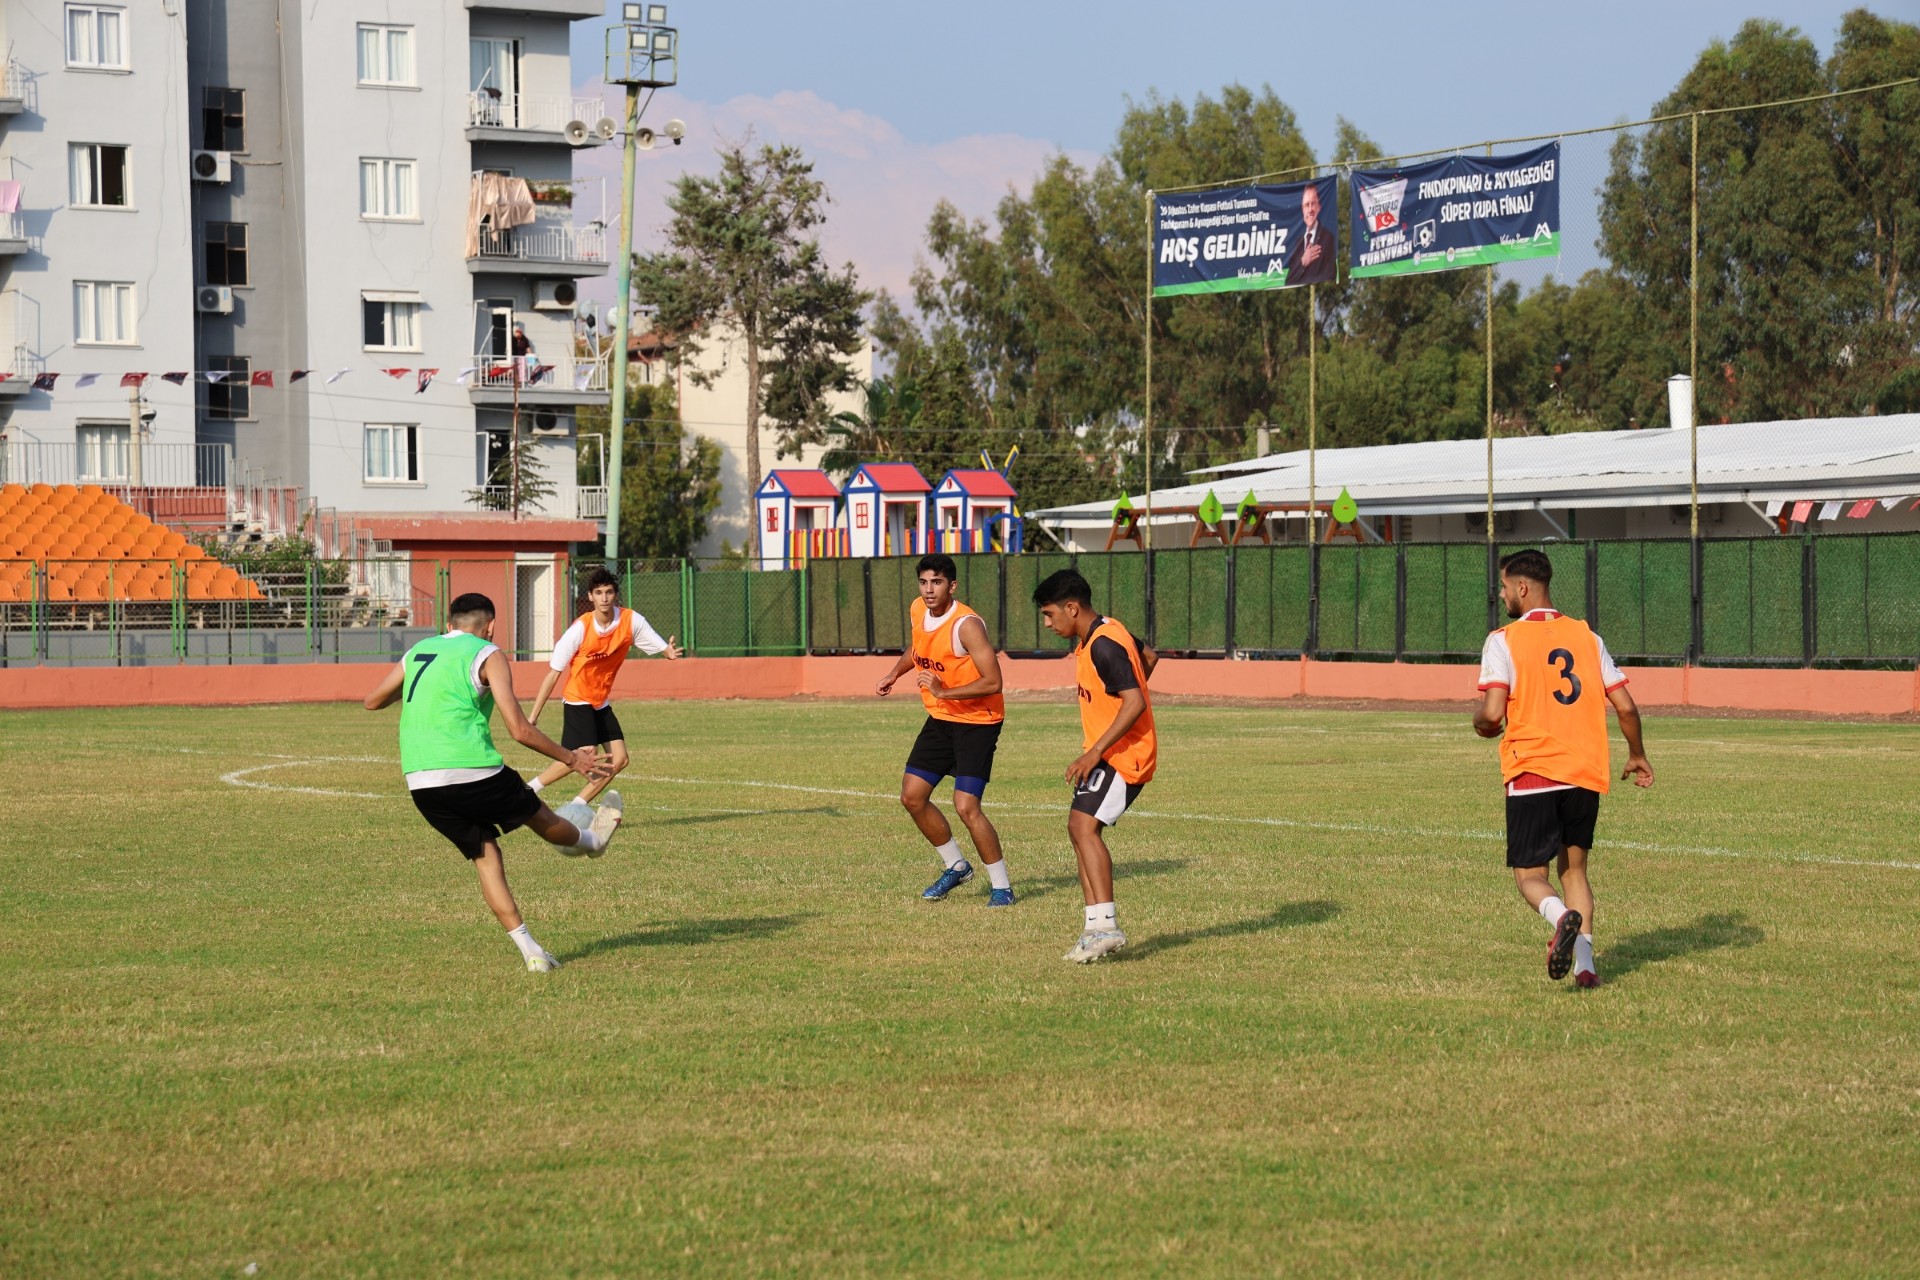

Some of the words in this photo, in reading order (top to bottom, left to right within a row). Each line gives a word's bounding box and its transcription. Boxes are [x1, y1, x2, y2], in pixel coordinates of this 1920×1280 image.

[1419, 174, 1482, 200] FINDIKPINARI
[1484, 174, 1492, 191] &
[1494, 159, 1555, 188] AYVAGEDİĞİ
[1221, 214, 1236, 226] Süper
[1236, 213, 1249, 224] Kupa
[1440, 202, 1470, 224] SÜPER
[1472, 200, 1497, 220] KUPA
[1500, 191, 1534, 216] FİNALİ
[1160, 237, 1199, 268] HOŞ
[1203, 223, 1288, 261] GELDİNİZ
[406, 653, 438, 703] 7
[1547, 647, 1582, 706] 3
